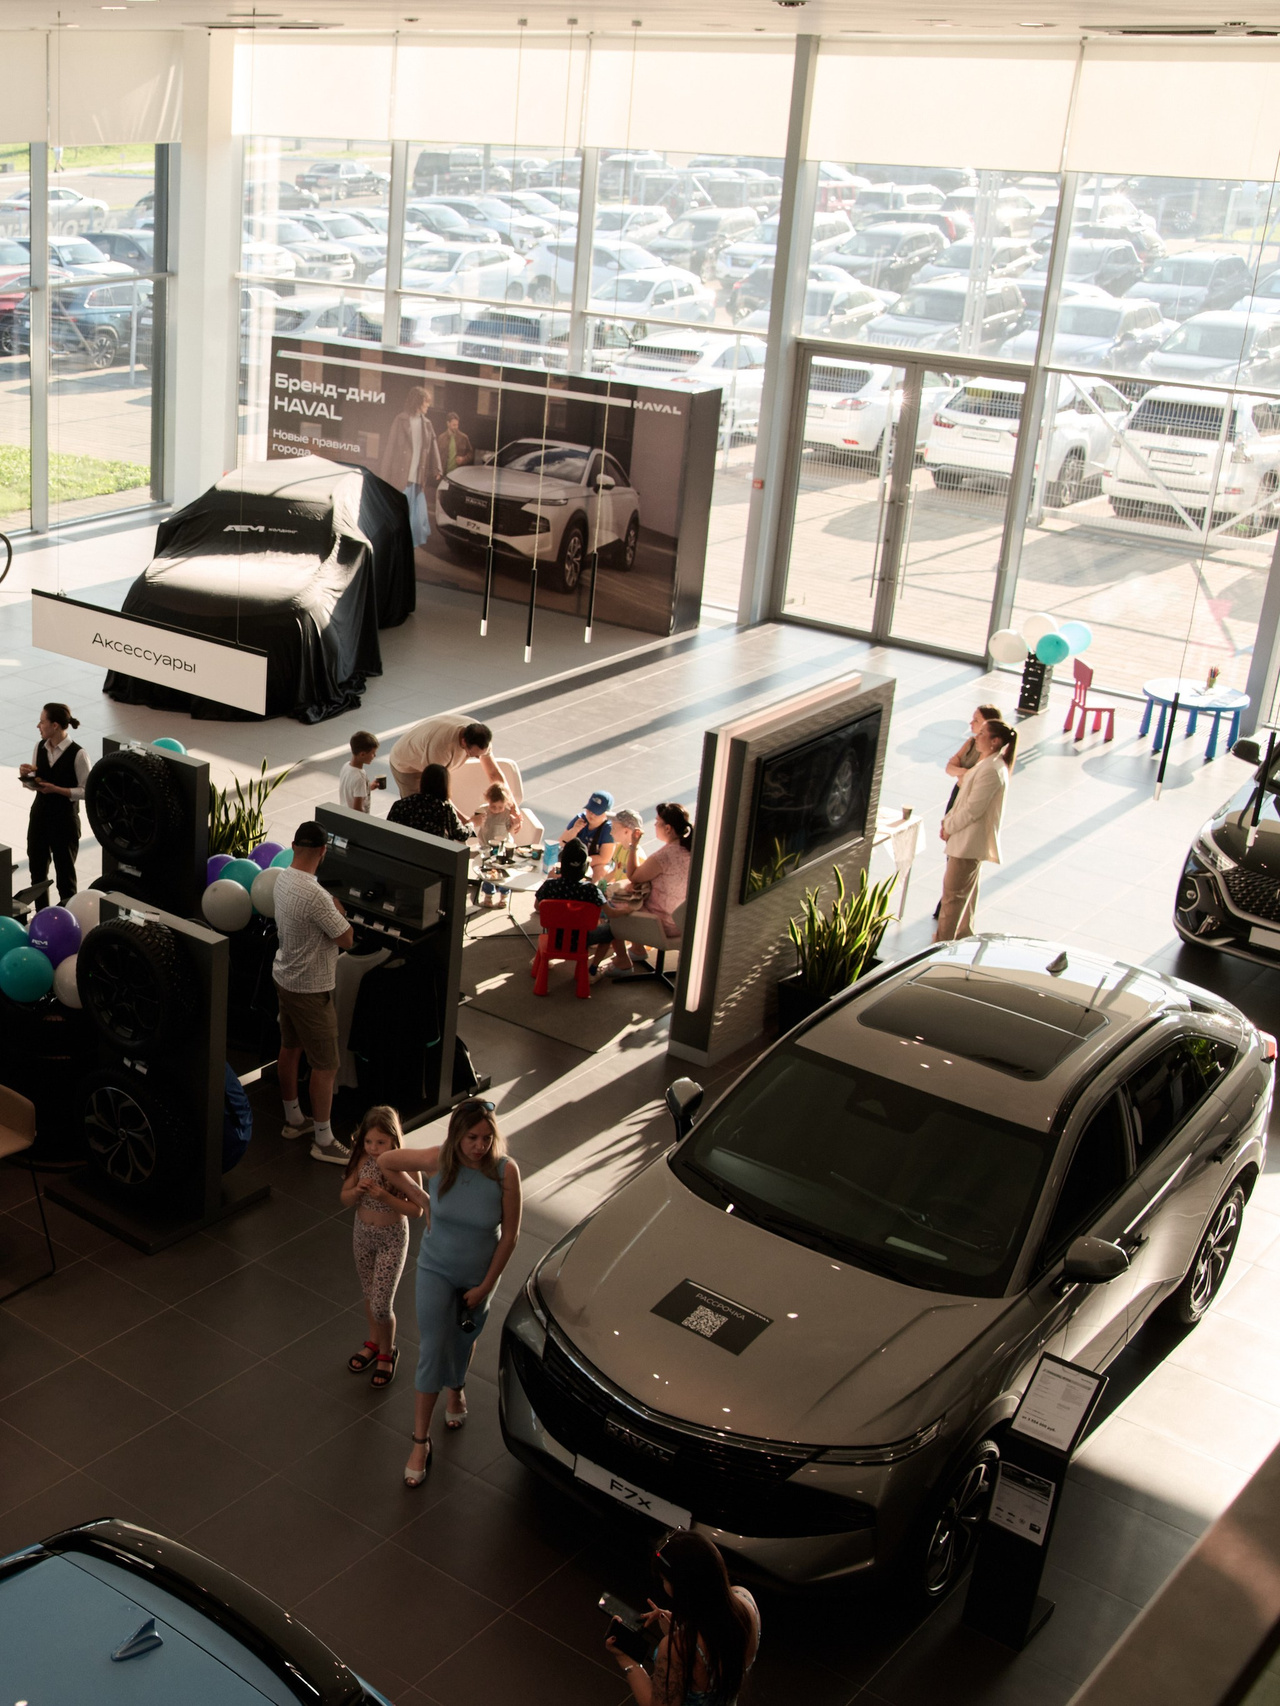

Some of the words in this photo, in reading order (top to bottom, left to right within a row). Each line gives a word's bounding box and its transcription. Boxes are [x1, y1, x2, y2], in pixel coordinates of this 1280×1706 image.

[275, 372, 386, 404] Бренд-дни
[274, 395, 343, 421] HAVAL
[633, 400, 682, 416] HAVAL
[272, 428, 309, 444] Новые
[312, 437, 361, 453] правила
[272, 443, 311, 457] города
[92, 632, 196, 673] Аксессуары
[695, 1292, 747, 1321] РАССРОЧКА
[609, 1479, 652, 1511] F7x
